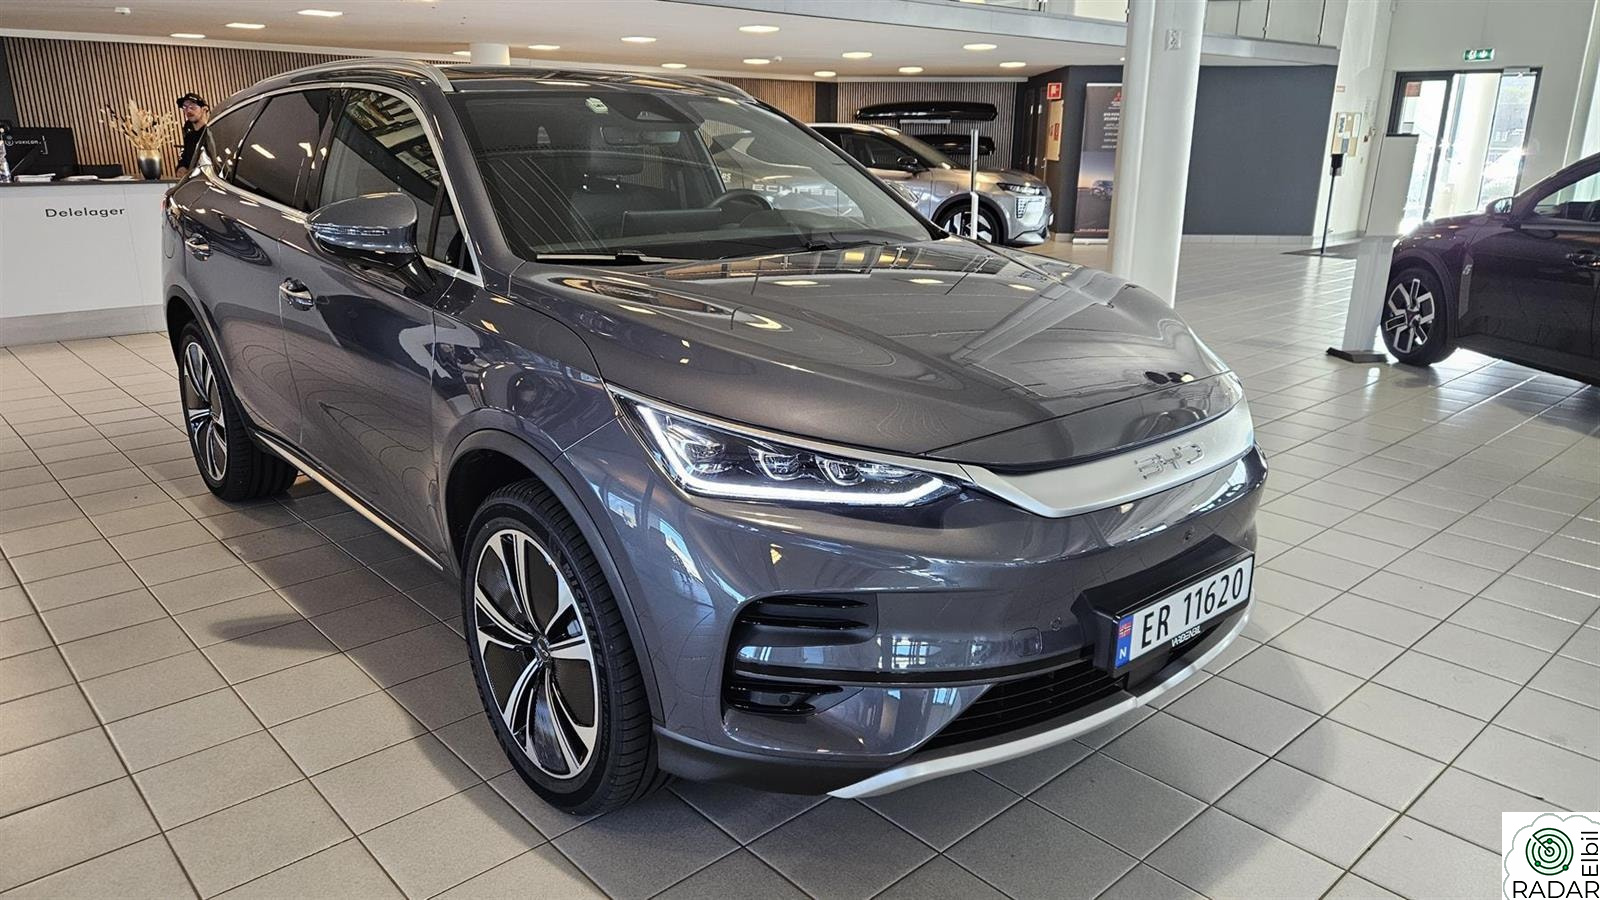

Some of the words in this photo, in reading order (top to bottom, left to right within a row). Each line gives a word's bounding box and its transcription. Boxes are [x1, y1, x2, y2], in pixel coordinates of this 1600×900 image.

[752, 183, 837, 196] ECLIPSE
[45, 207, 125, 217] Delelager
[1134, 444, 1204, 480] BYD
[1141, 604, 1171, 648] ER
[1183, 567, 1243, 626] 11620
[1119, 647, 1127, 659] N
